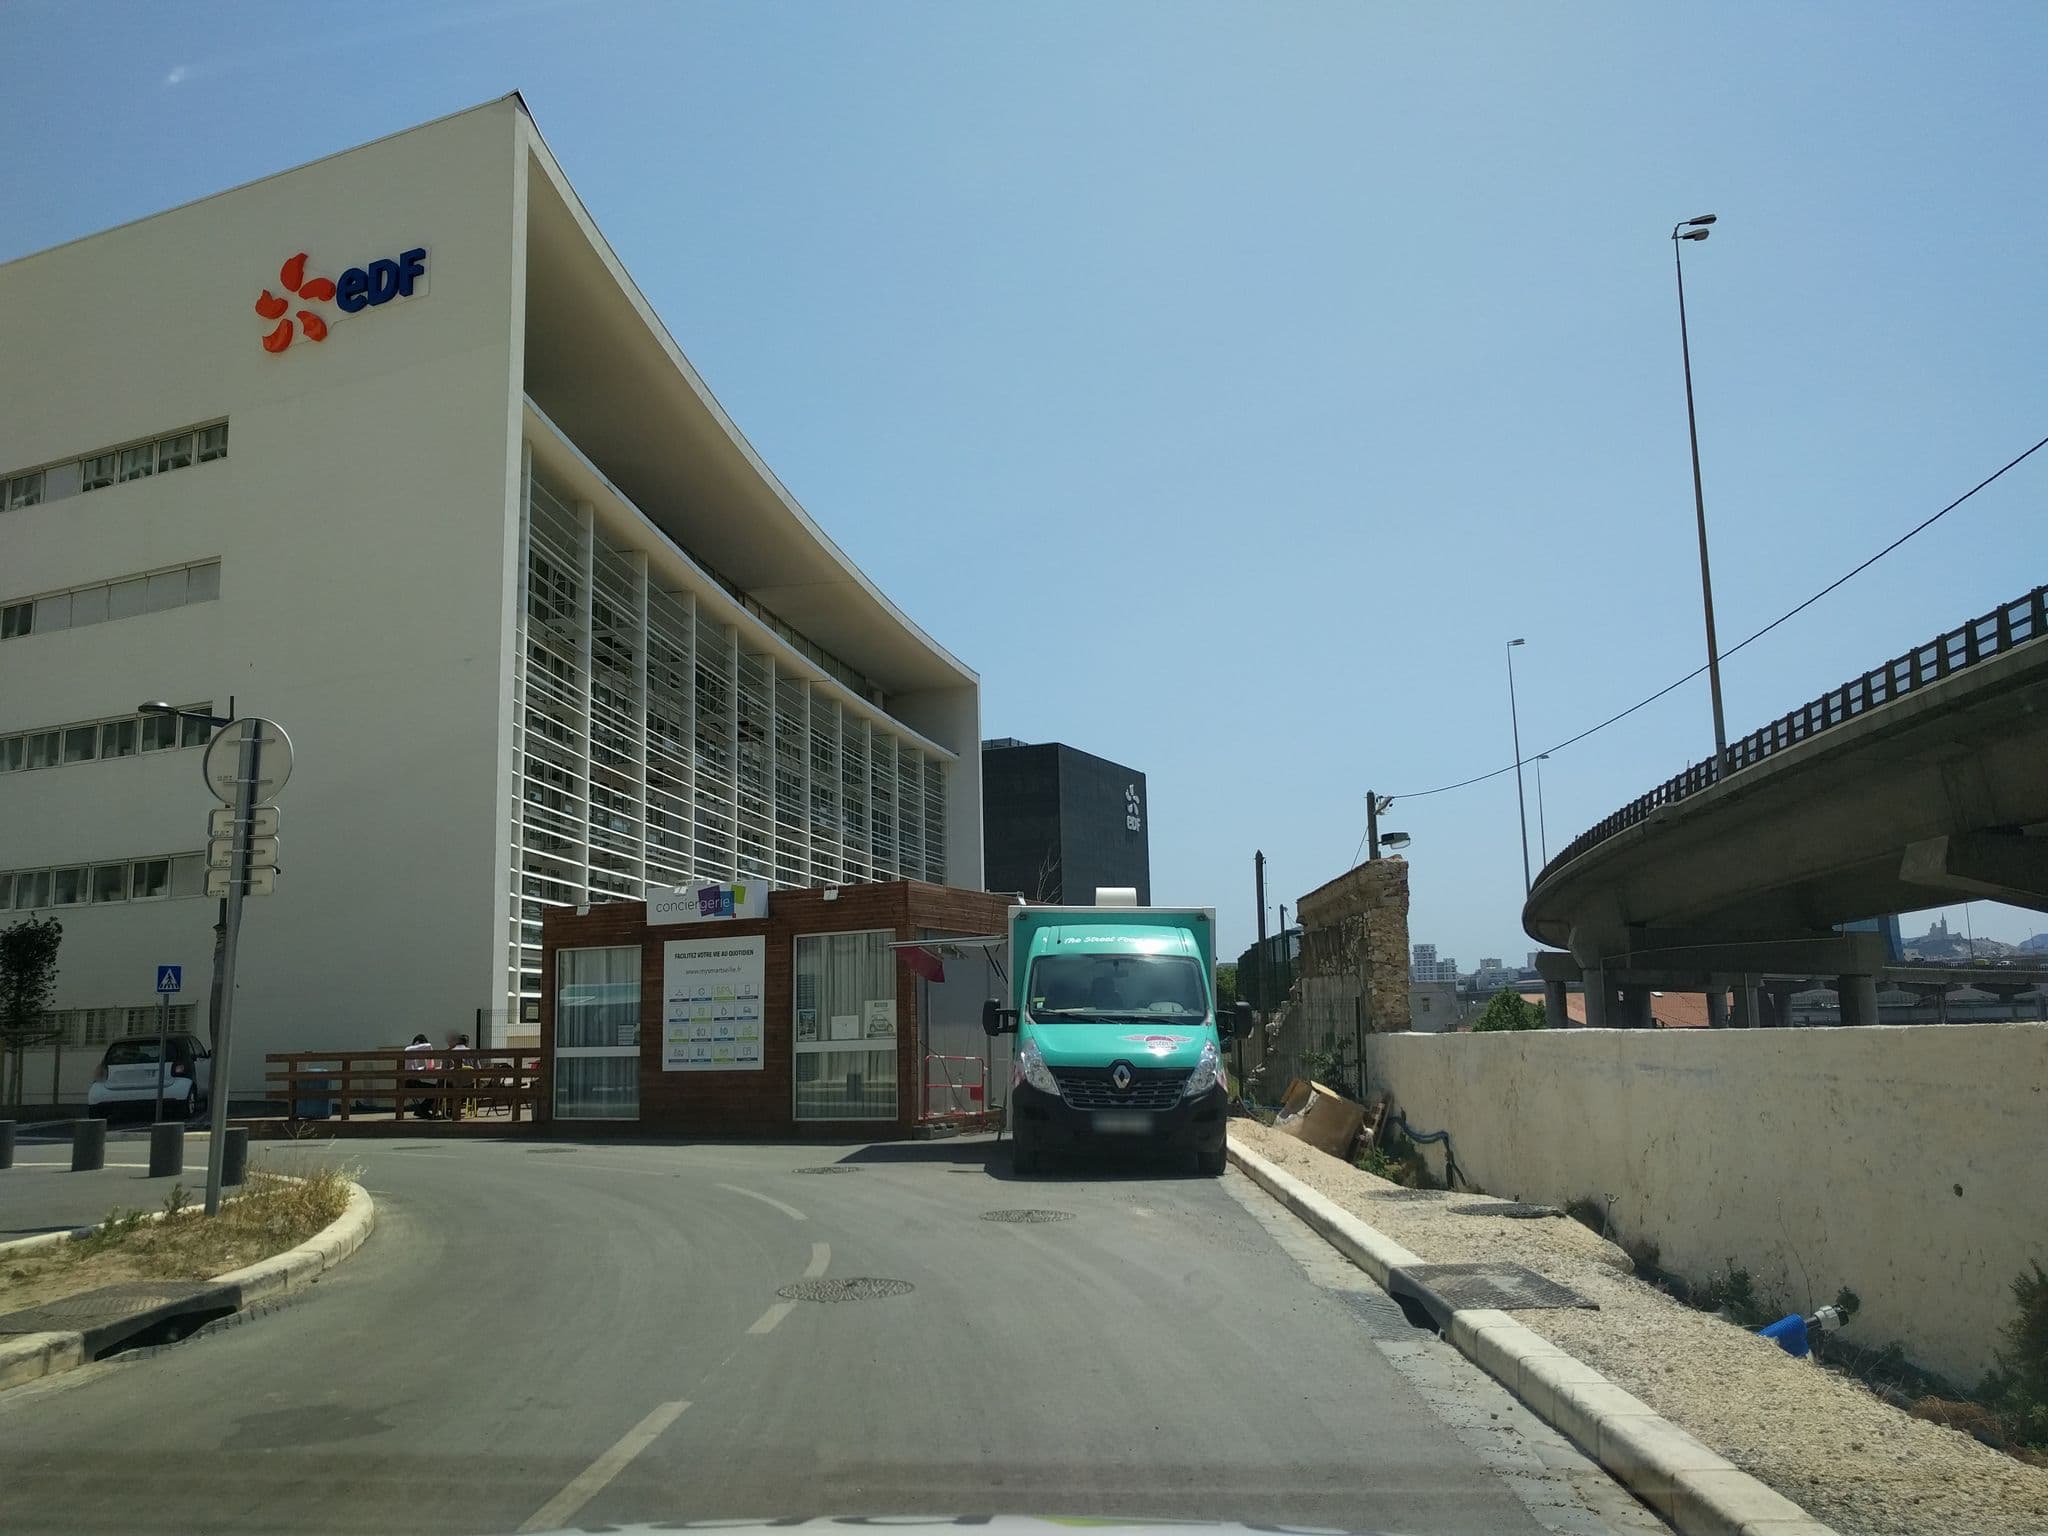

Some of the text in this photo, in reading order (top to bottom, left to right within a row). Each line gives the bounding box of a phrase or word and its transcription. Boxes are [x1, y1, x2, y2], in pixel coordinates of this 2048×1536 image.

[656, 897, 730, 913] conciergerie
[1064, 936, 1081, 944] The
[729, 949, 754, 957] QUOTIDIEN
